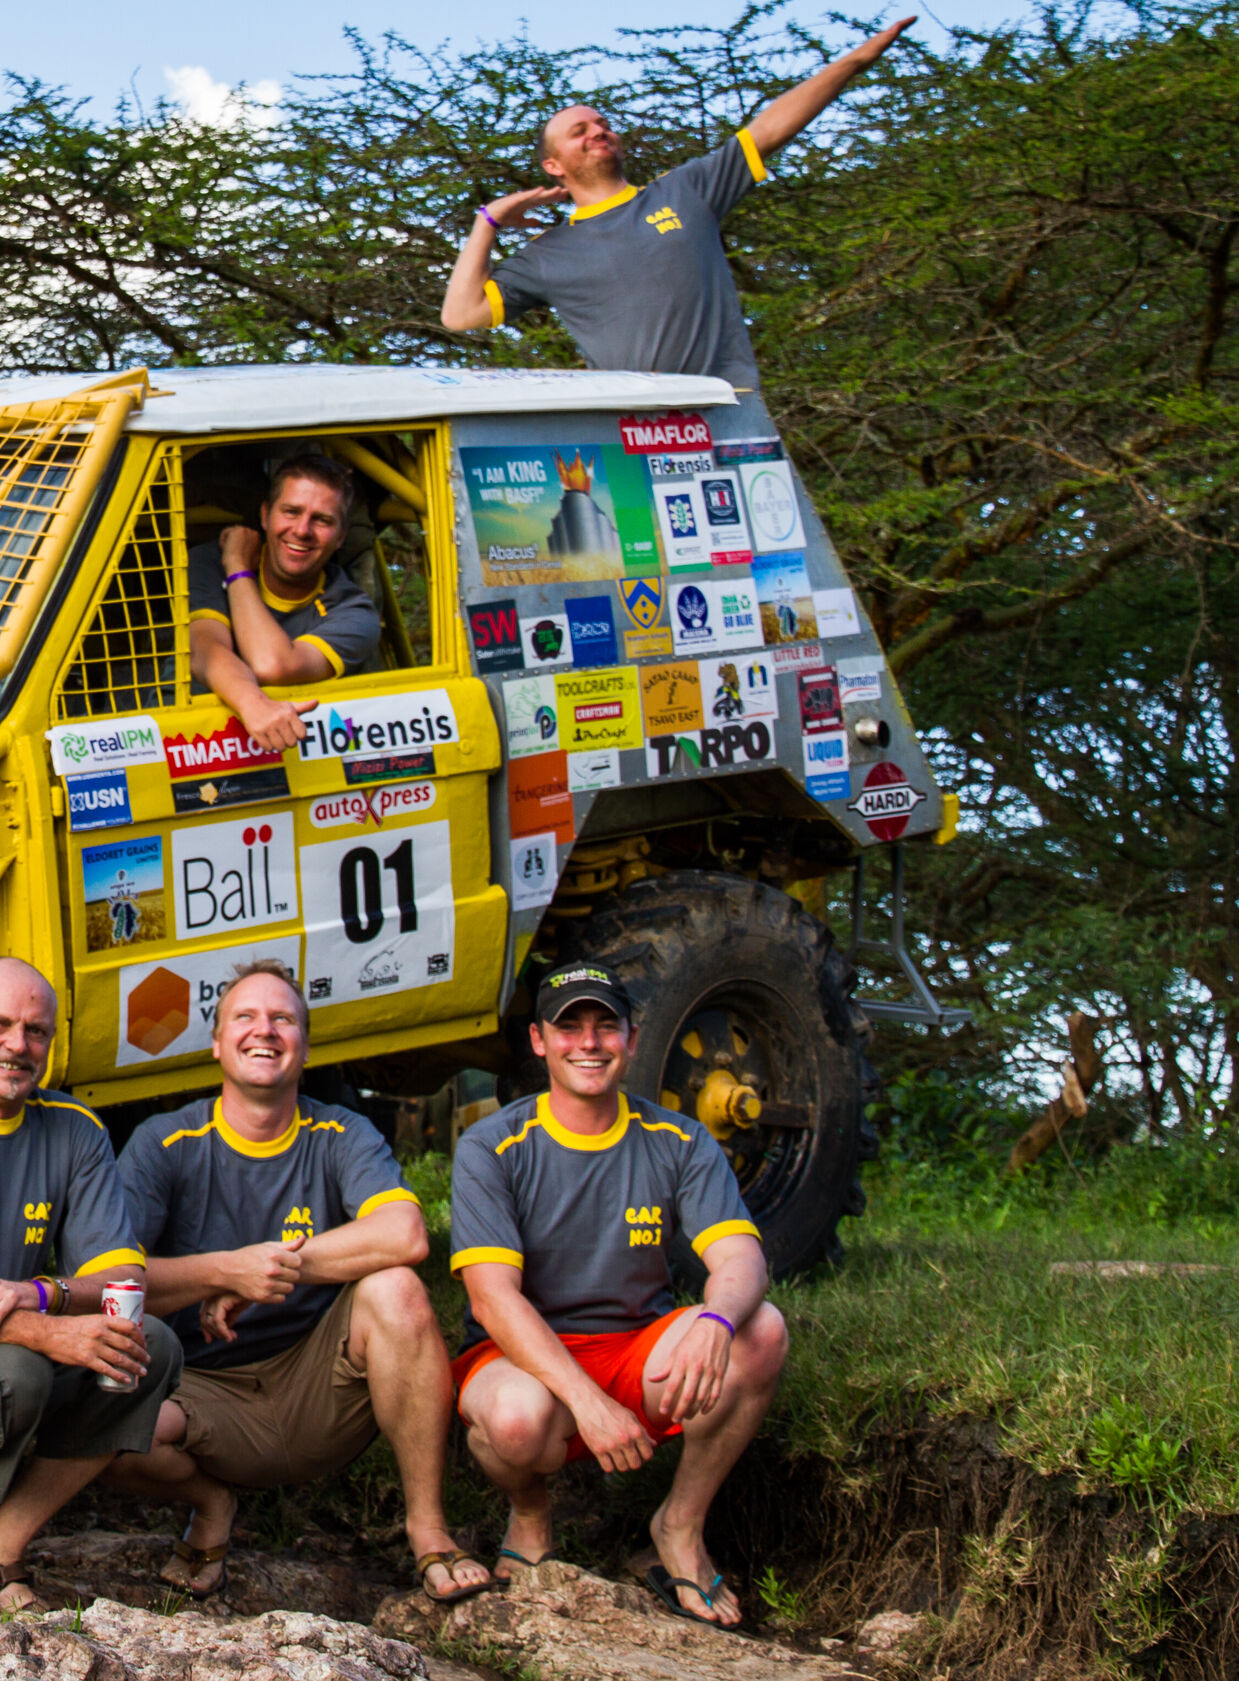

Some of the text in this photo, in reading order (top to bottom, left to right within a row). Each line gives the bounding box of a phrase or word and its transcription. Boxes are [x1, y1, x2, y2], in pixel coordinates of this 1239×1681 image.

[622, 423, 709, 447] TIMAFLOR
[507, 460, 547, 482] KING
[651, 454, 710, 474] Florensis
[471, 608, 517, 648] SW
[774, 645, 820, 662] LITTLE RED
[557, 677, 623, 697] TOOLCRAFTS
[679, 709, 699, 723] EAST
[89, 728, 155, 753] realIPM
[299, 706, 452, 757] Florensis
[167, 736, 283, 768] TIMAFLO
[85, 787, 125, 810] USN
[864, 791, 909, 812] HARDI
[126, 843, 158, 857] GRAINS
[183, 824, 272, 929] Ball
[340, 839, 417, 944] 01
[625, 1206, 663, 1225] CAR
[629, 1228, 662, 1247] NO.1
